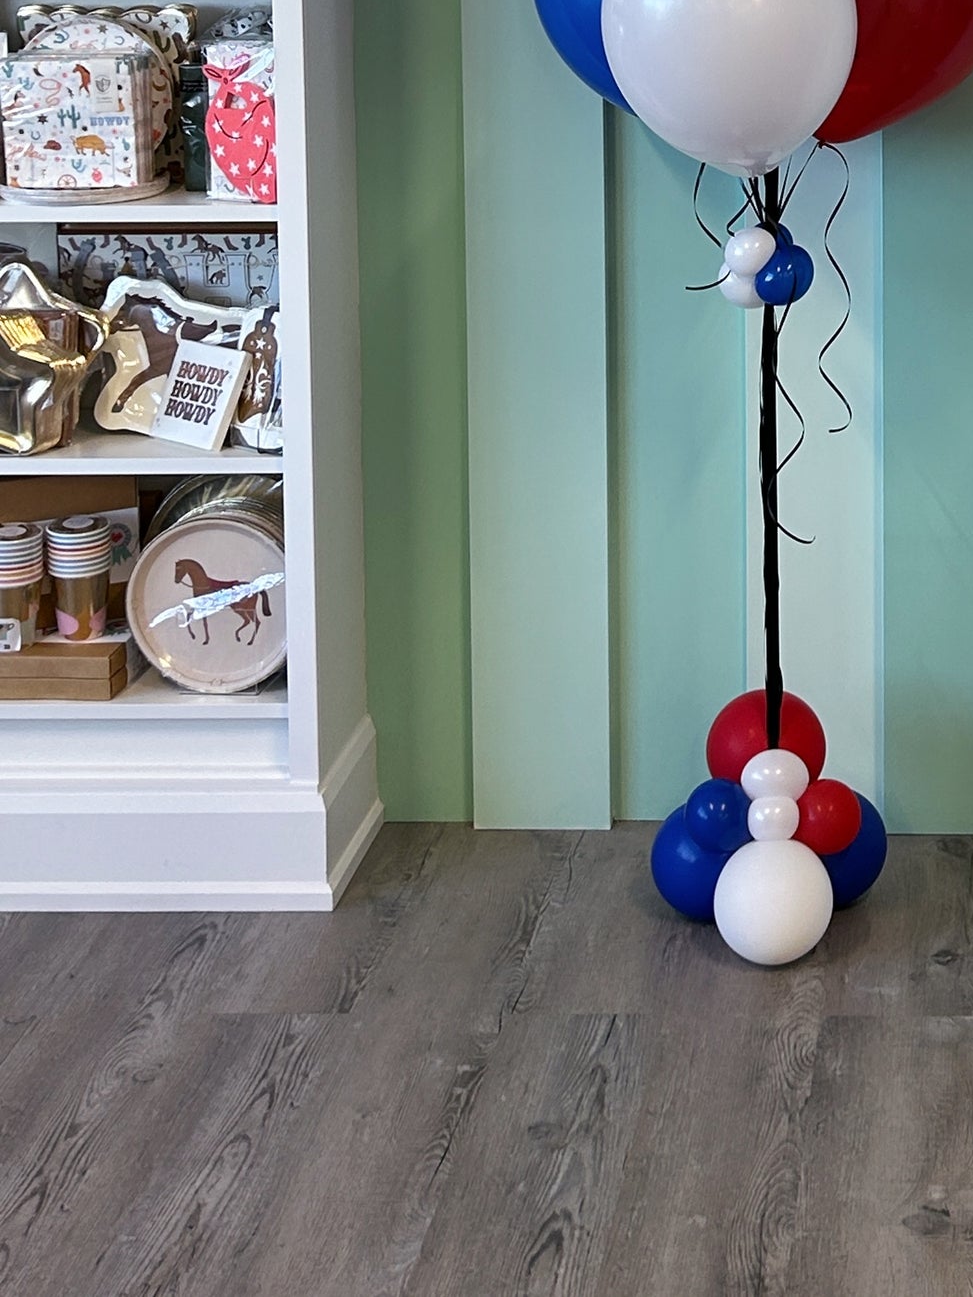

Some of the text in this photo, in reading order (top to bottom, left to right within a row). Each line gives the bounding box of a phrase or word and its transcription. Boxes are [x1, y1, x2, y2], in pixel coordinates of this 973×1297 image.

[89, 116, 130, 126] HOWDY
[177, 360, 230, 387] HOWDY
[170, 379, 224, 407] HOWDY
[164, 398, 216, 426] HOWDY
